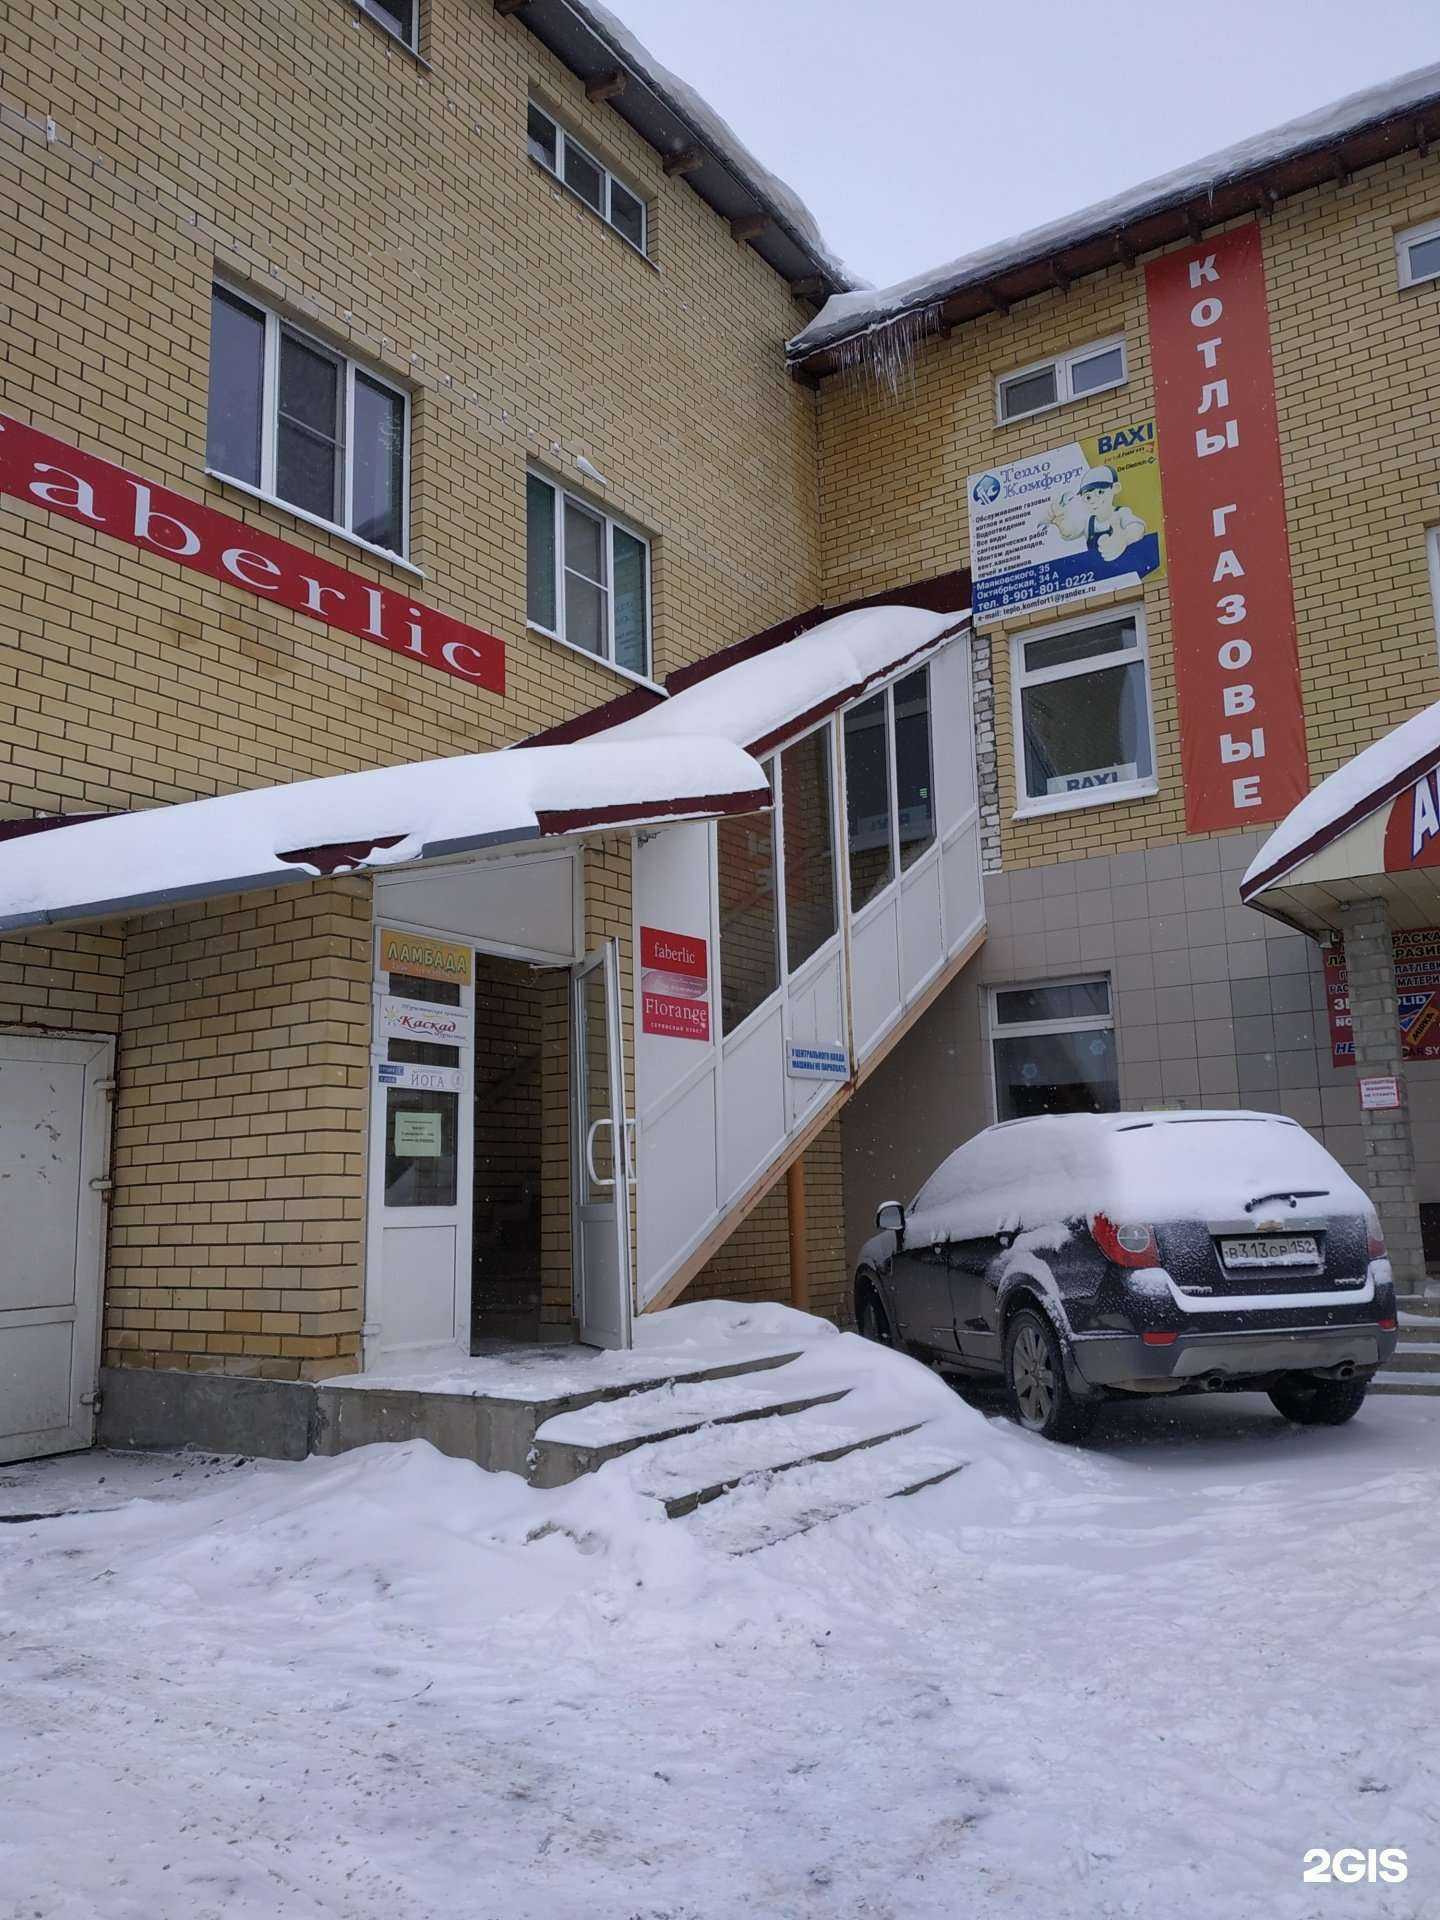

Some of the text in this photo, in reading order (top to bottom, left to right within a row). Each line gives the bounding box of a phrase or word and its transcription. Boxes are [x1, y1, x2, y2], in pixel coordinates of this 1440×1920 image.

[1189, 254, 1240, 458] КОТЛЫ
[1098, 422, 1153, 455] BAXI
[0, 424, 482, 677] aberlic
[976, 564, 1050, 591] Маяковского, 35
[976, 579, 1037, 600] Октябрьская,
[1039, 573, 1050, 583] 34
[977, 571, 1095, 611] тел. 8-901-801-0222
[1212, 504, 1265, 808] ГАЗОВЫЕ
[1066, 772, 1118, 791] BAXI
[388, 941, 467, 973] ЛАМБАДА
[654, 942, 696, 964] faberlic
[400, 1015, 456, 1034] Каскад
[645, 998, 708, 1025] Florange
[410, 1070, 445, 1088] ЙОГА
